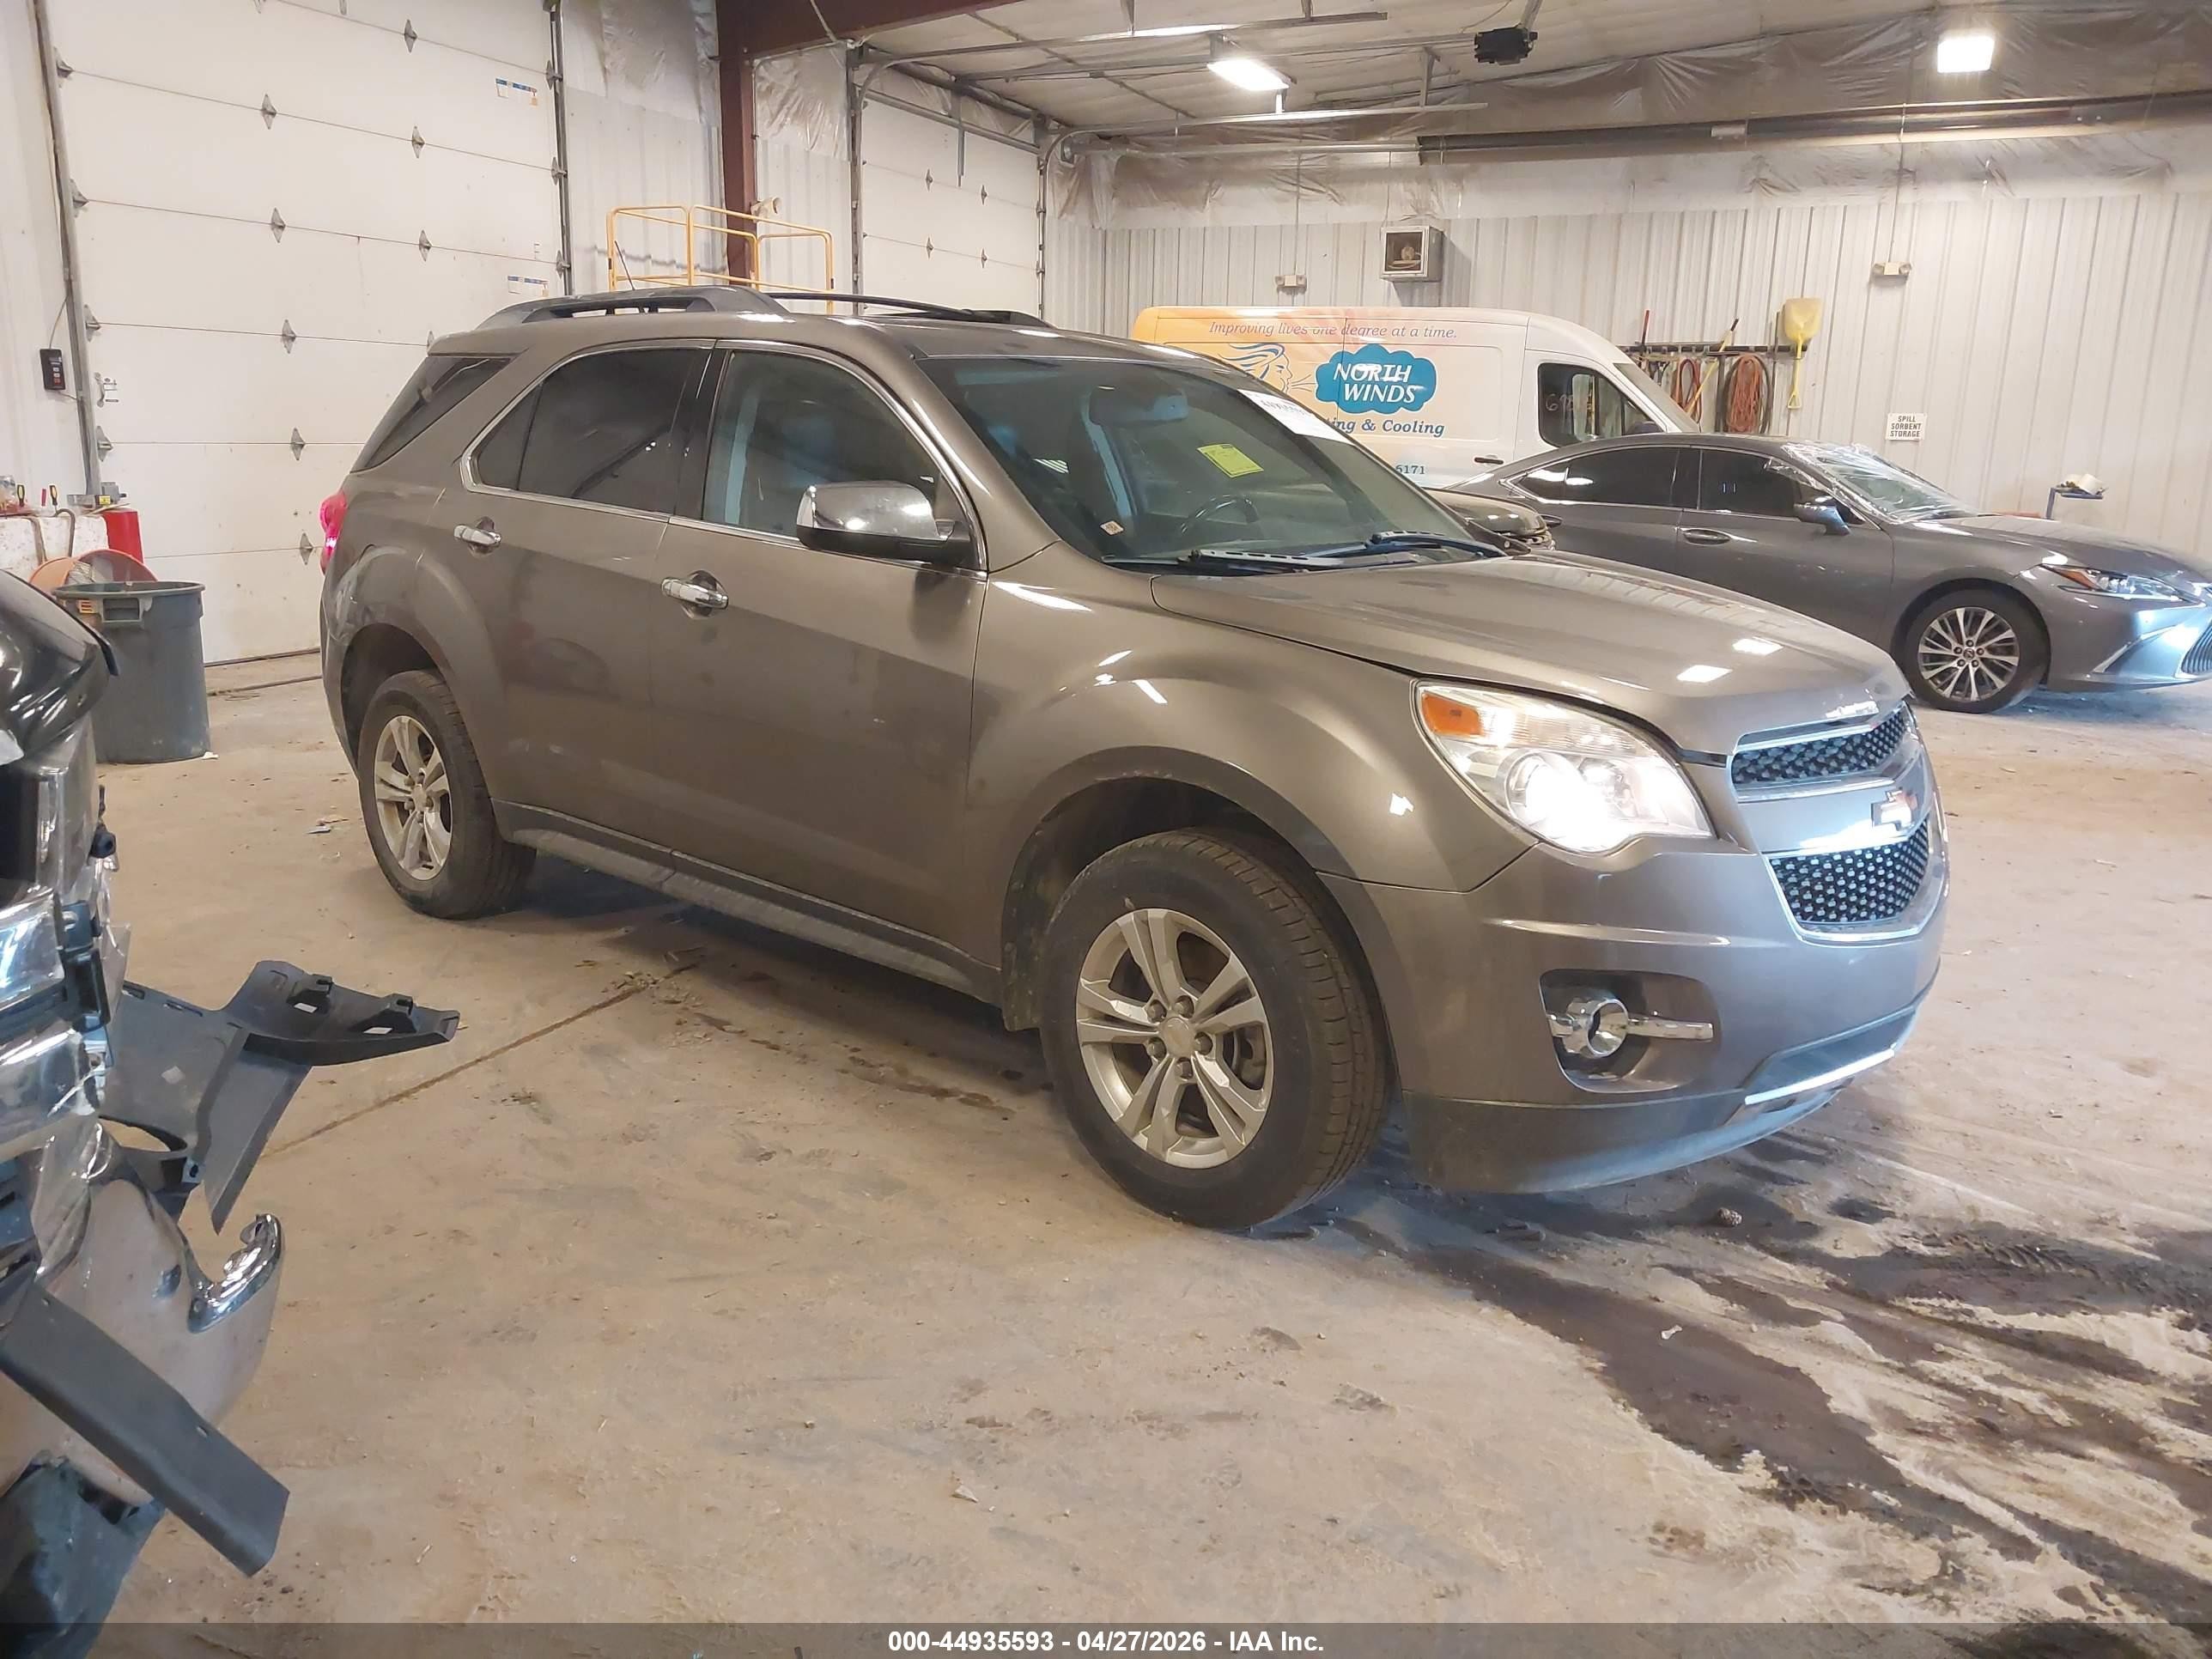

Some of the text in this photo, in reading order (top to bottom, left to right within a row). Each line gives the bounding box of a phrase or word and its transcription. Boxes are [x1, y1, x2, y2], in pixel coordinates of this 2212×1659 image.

[1209, 321, 1274, 337] Improving
[1279, 322, 1308, 335] lives
[1341, 324, 1387, 337] degree
[1391, 326, 1405, 337] at
[1424, 325, 1457, 338] time.
[1333, 362, 1411, 382] NORTH
[1343, 383, 1419, 403] WINDS
[1361, 418, 1376, 431] &
[1382, 419, 1445, 437] Cooling
